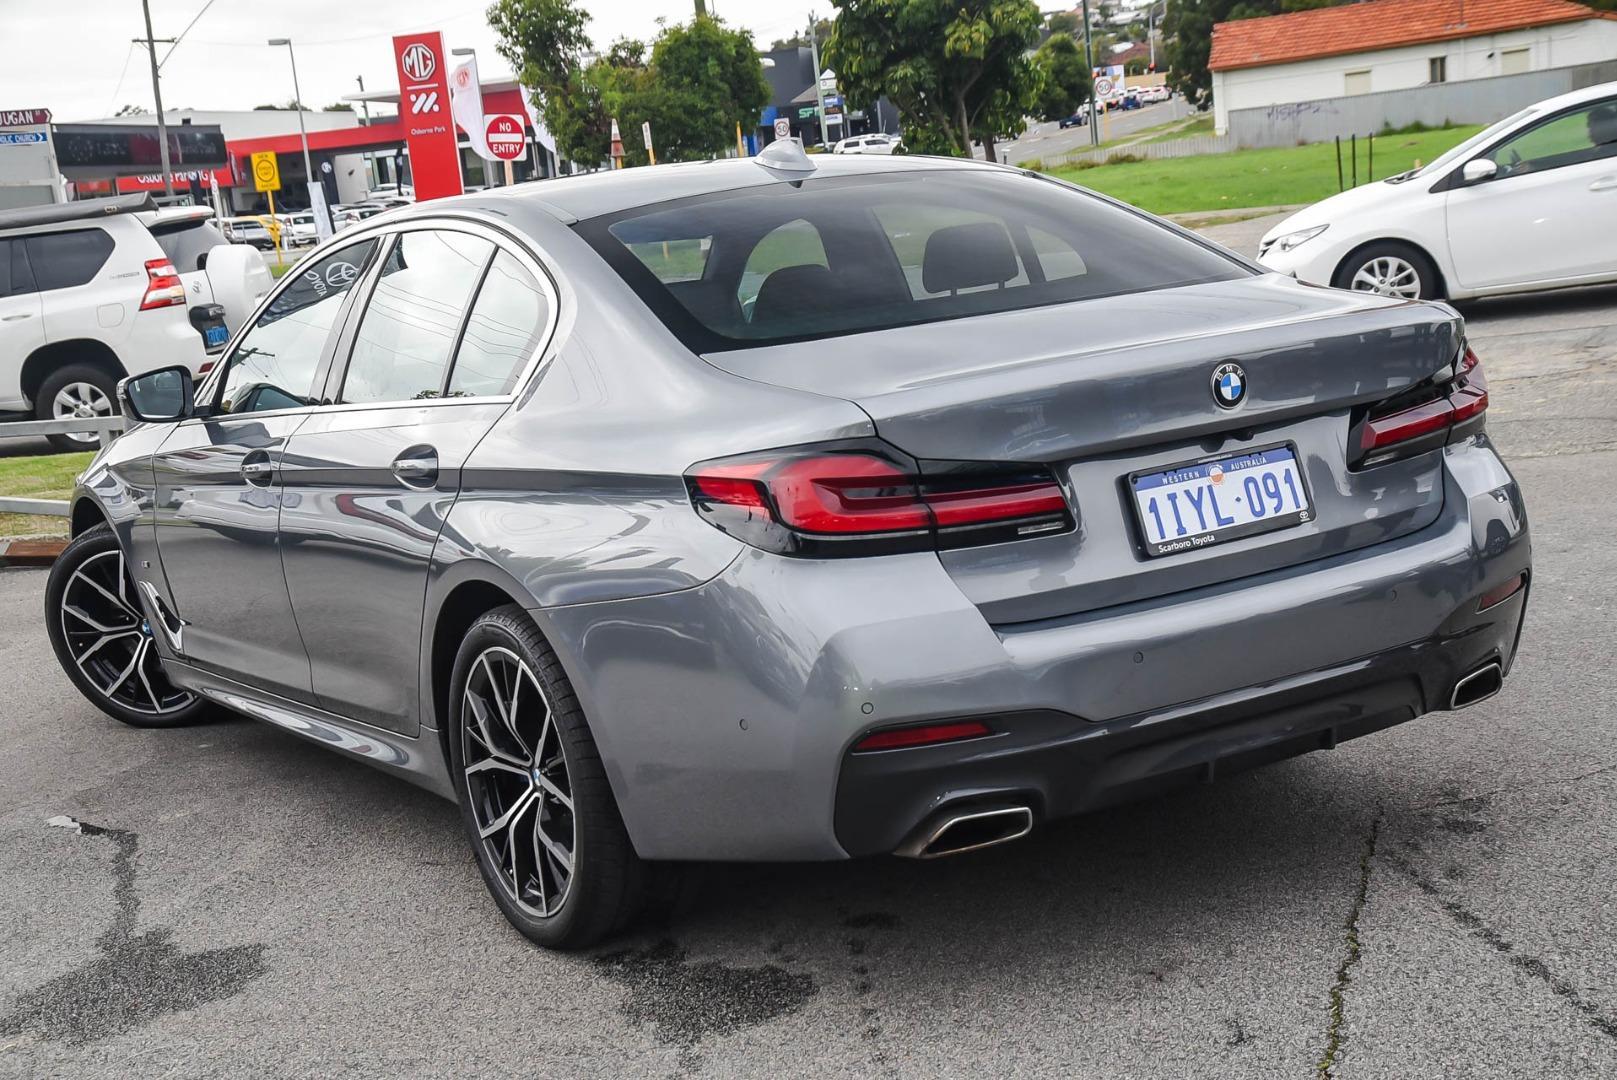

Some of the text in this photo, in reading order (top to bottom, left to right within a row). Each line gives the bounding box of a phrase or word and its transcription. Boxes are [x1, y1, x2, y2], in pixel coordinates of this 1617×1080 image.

[405, 46, 433, 78] MG
[411, 128, 433, 136] Osborne
[500, 122, 512, 132] NO
[493, 143, 521, 154] ENTRY
[1216, 365, 1244, 381] BMW
[1162, 471, 1200, 485] WESTERN
[1230, 456, 1267, 471] AUSTRALIA
[1158, 533, 1215, 553] Scarboro Toyota
